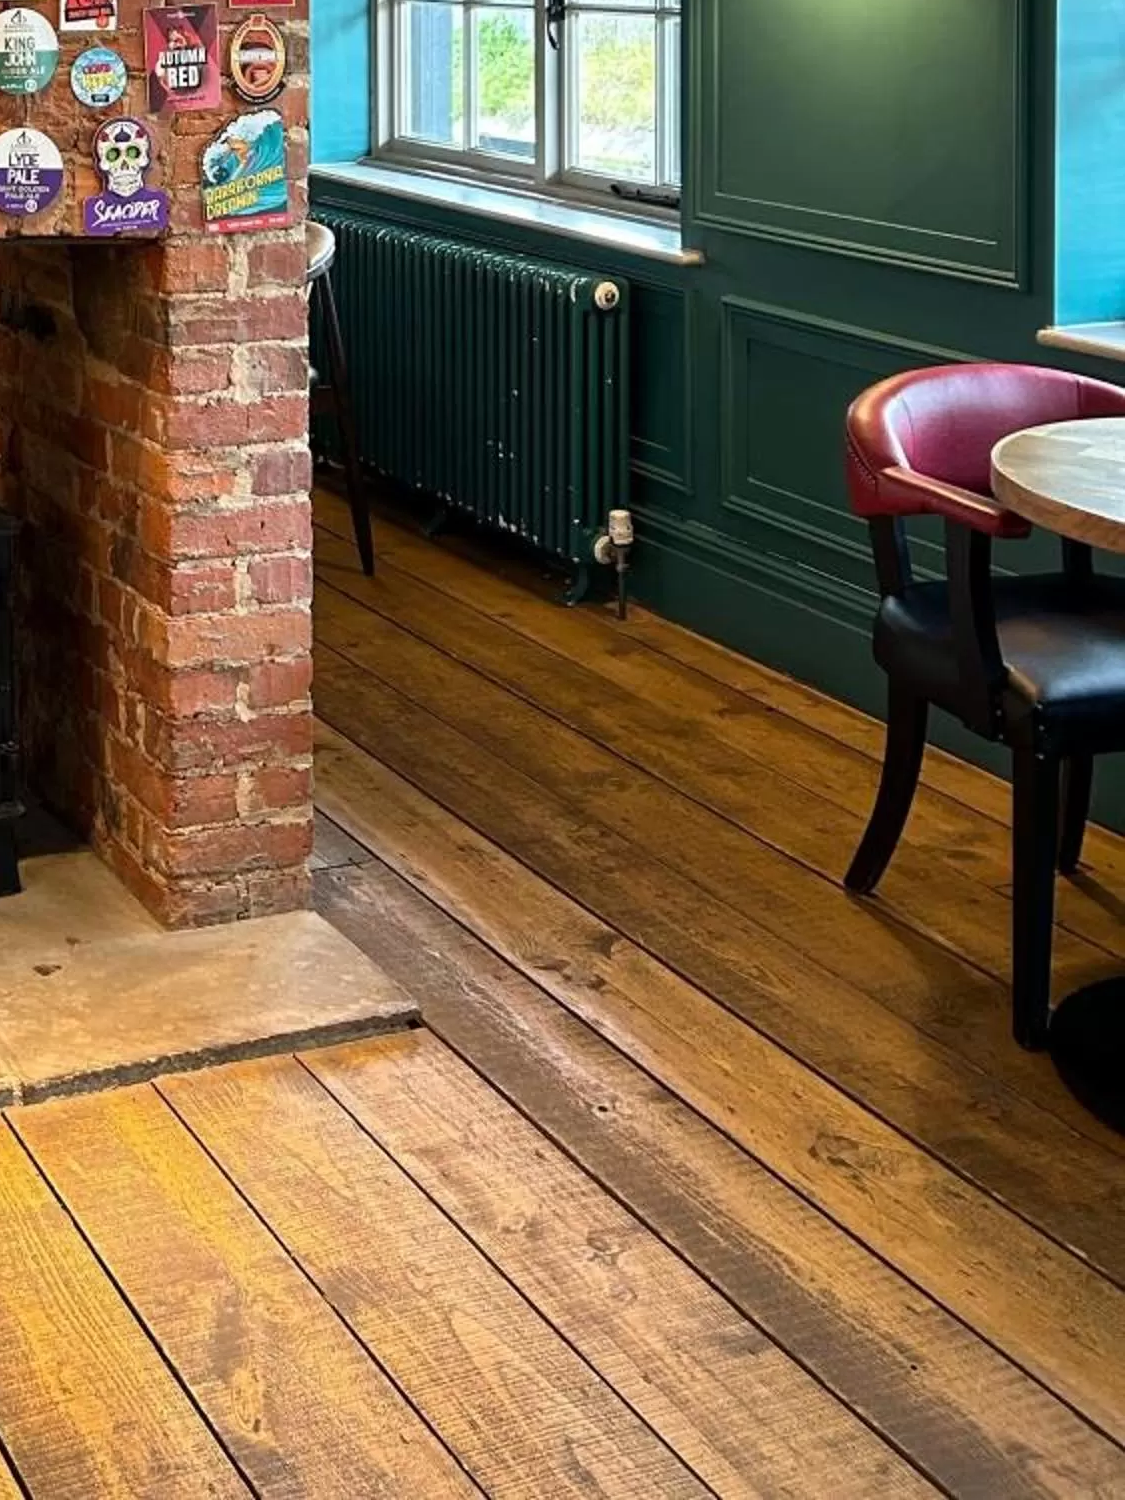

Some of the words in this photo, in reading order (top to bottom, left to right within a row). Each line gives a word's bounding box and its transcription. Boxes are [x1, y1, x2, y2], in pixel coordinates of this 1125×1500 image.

[4, 35, 35, 50] KING
[4, 50, 36, 67] JOHN
[158, 47, 206, 66] AUTUMN
[167, 65, 200, 89] RED
[8, 153, 40, 167] LYDE
[7, 168, 40, 185] PALE
[92, 199, 161, 226] SEACIDER
